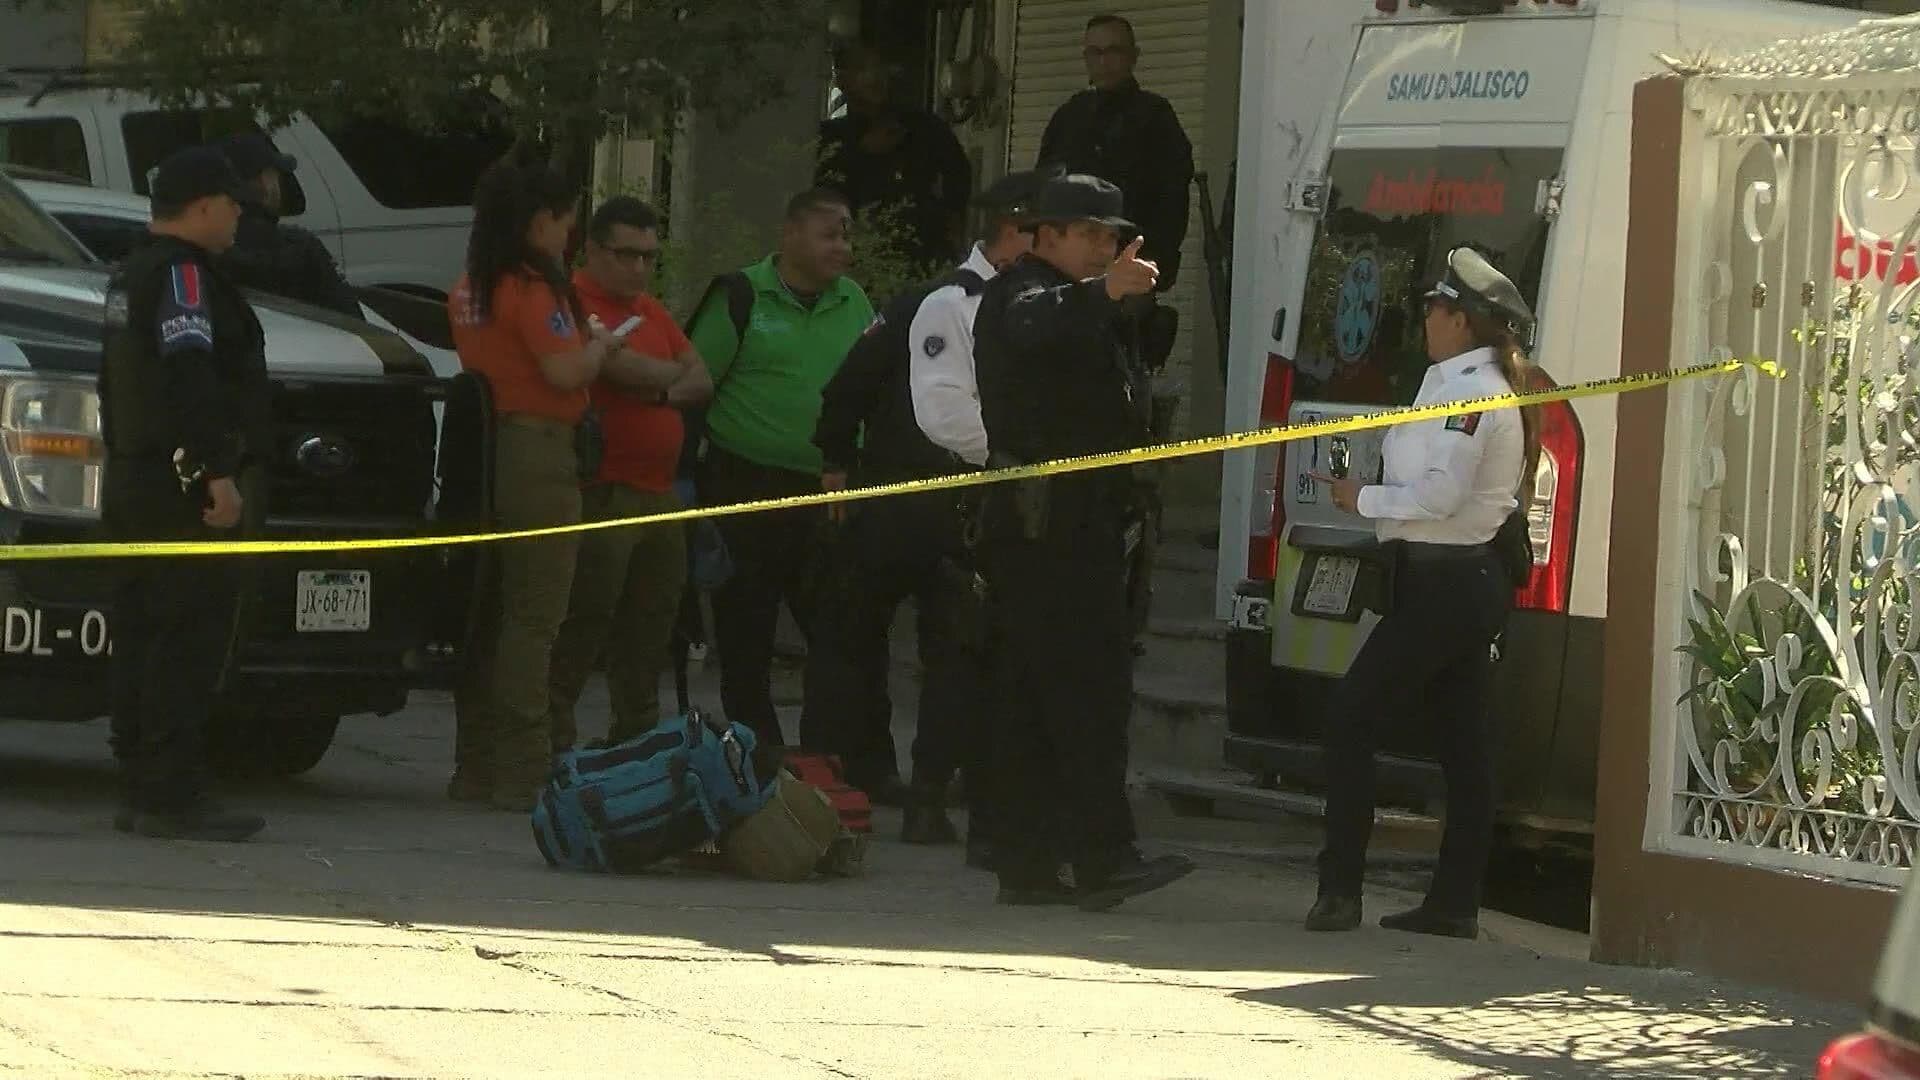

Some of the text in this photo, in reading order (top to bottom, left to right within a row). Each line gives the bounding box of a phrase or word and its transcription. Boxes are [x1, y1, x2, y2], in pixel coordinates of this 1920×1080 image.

[1387, 73, 1433, 101] SAMU
[1447, 70, 1529, 99] JALISCO
[301, 589, 367, 614] JX-68-771
[4, 607, 113, 656] DL-0
